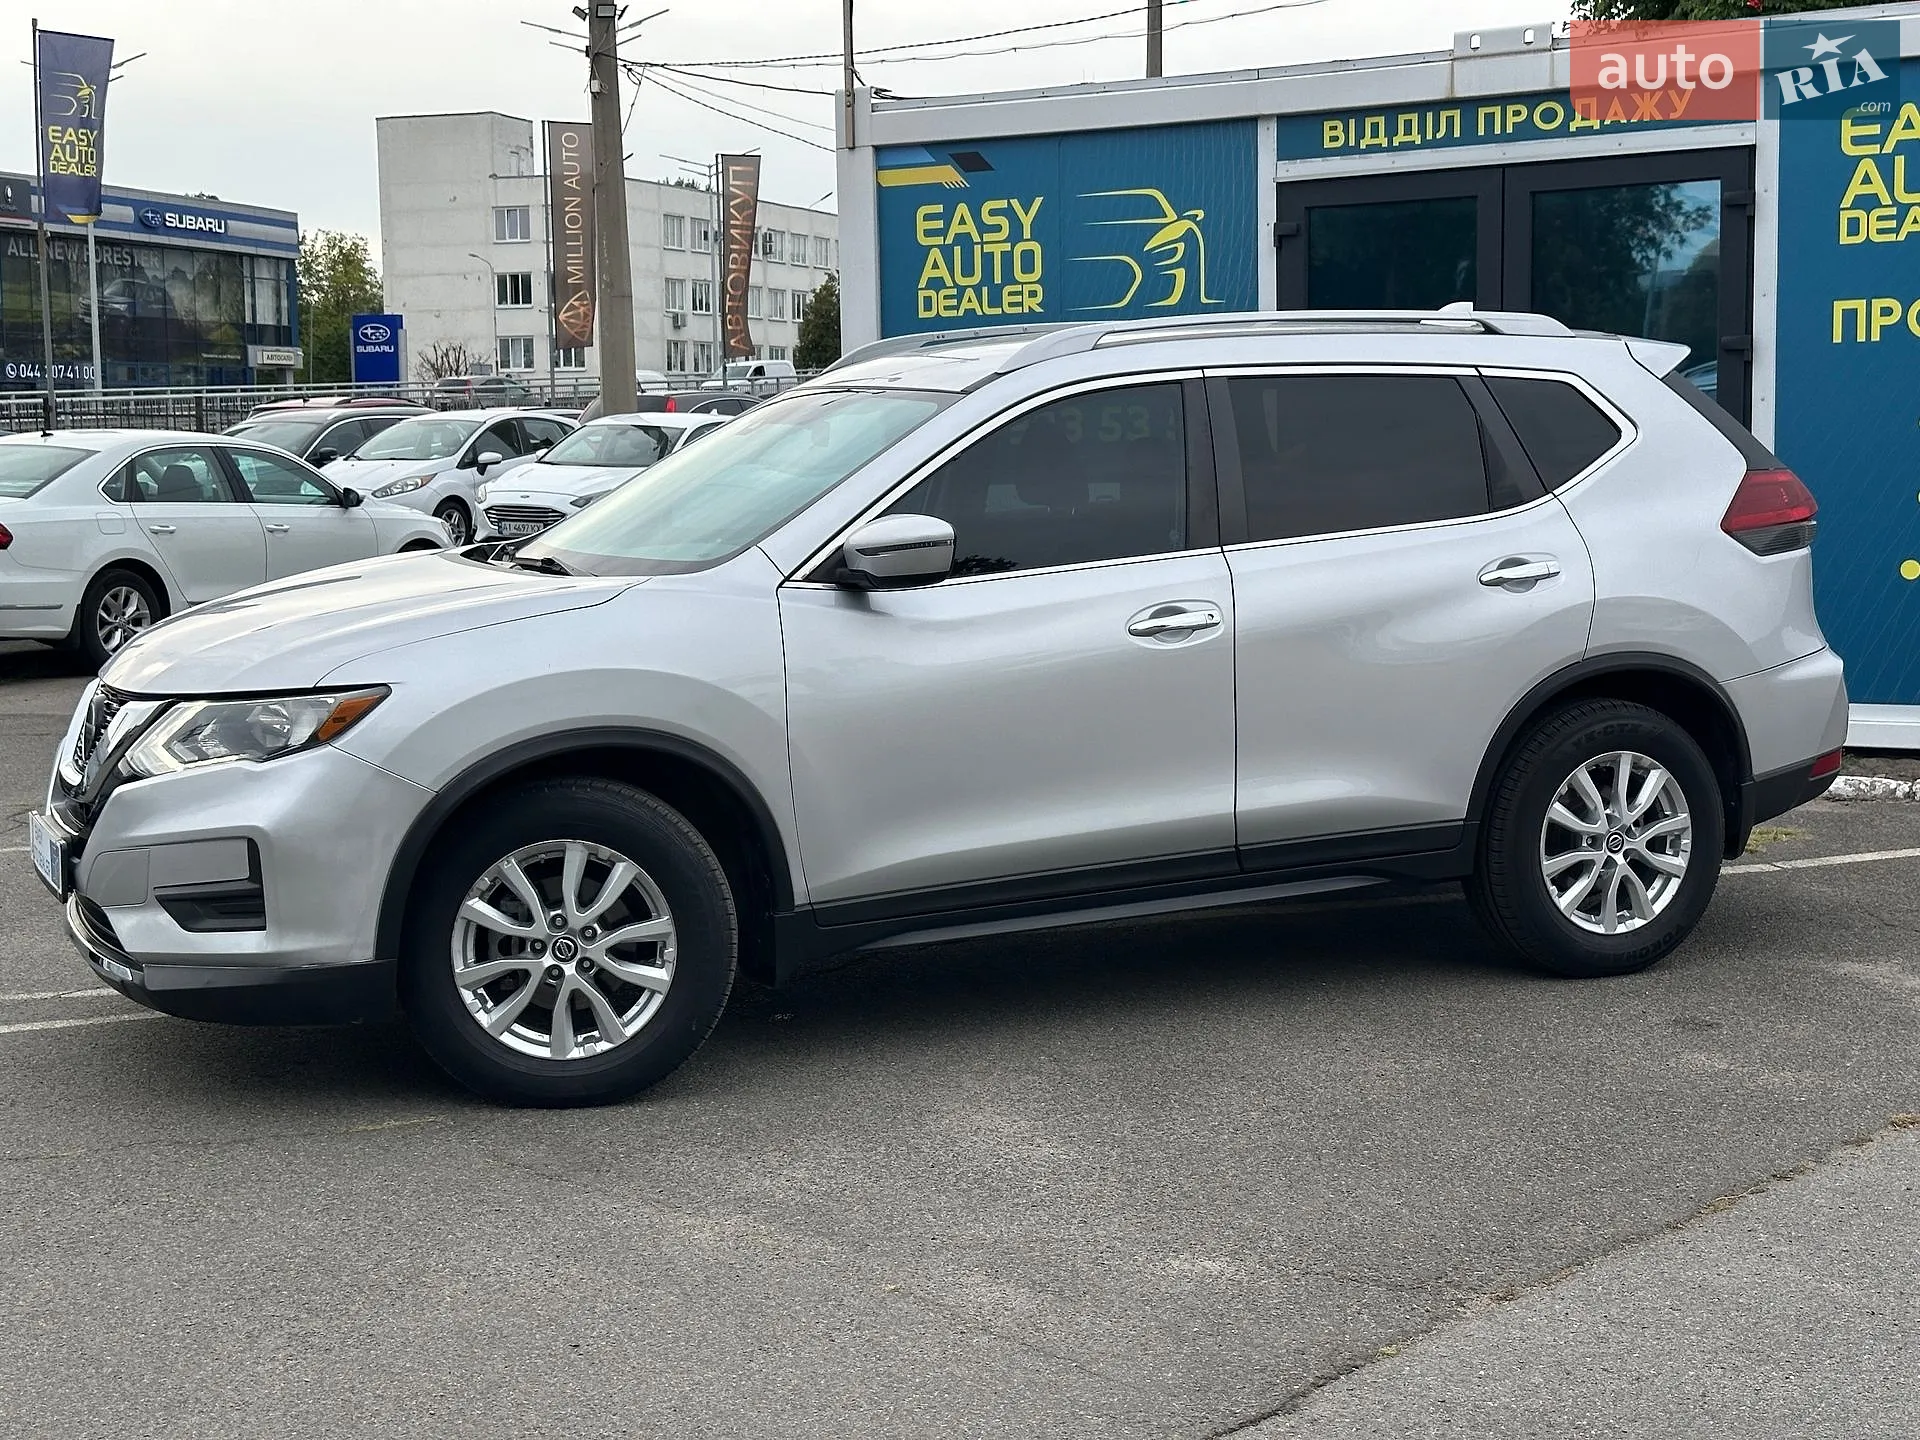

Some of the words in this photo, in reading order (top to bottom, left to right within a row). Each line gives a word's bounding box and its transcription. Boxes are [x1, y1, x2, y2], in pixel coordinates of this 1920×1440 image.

[48, 126, 98, 146] EASY
[1323, 108, 1461, 149] ВІДДІЛ
[49, 160, 97, 177] DEALER
[50, 144, 97, 164] AUTO
[562, 131, 581, 190] AUTO
[165, 212, 225, 234] SUBARU
[916, 197, 1044, 246] EASY
[7, 236, 39, 257] ALL
[44, 239, 79, 262] NEW
[564, 197, 584, 284] MILLION
[726, 164, 754, 350] АВТОВИКУП
[918, 241, 1042, 288] AUTO
[918, 283, 1044, 319] DEALER
[1832, 298, 1920, 344] ПР
[356, 345, 394, 353] SUBARU
[20, 363, 40, 378] 044
